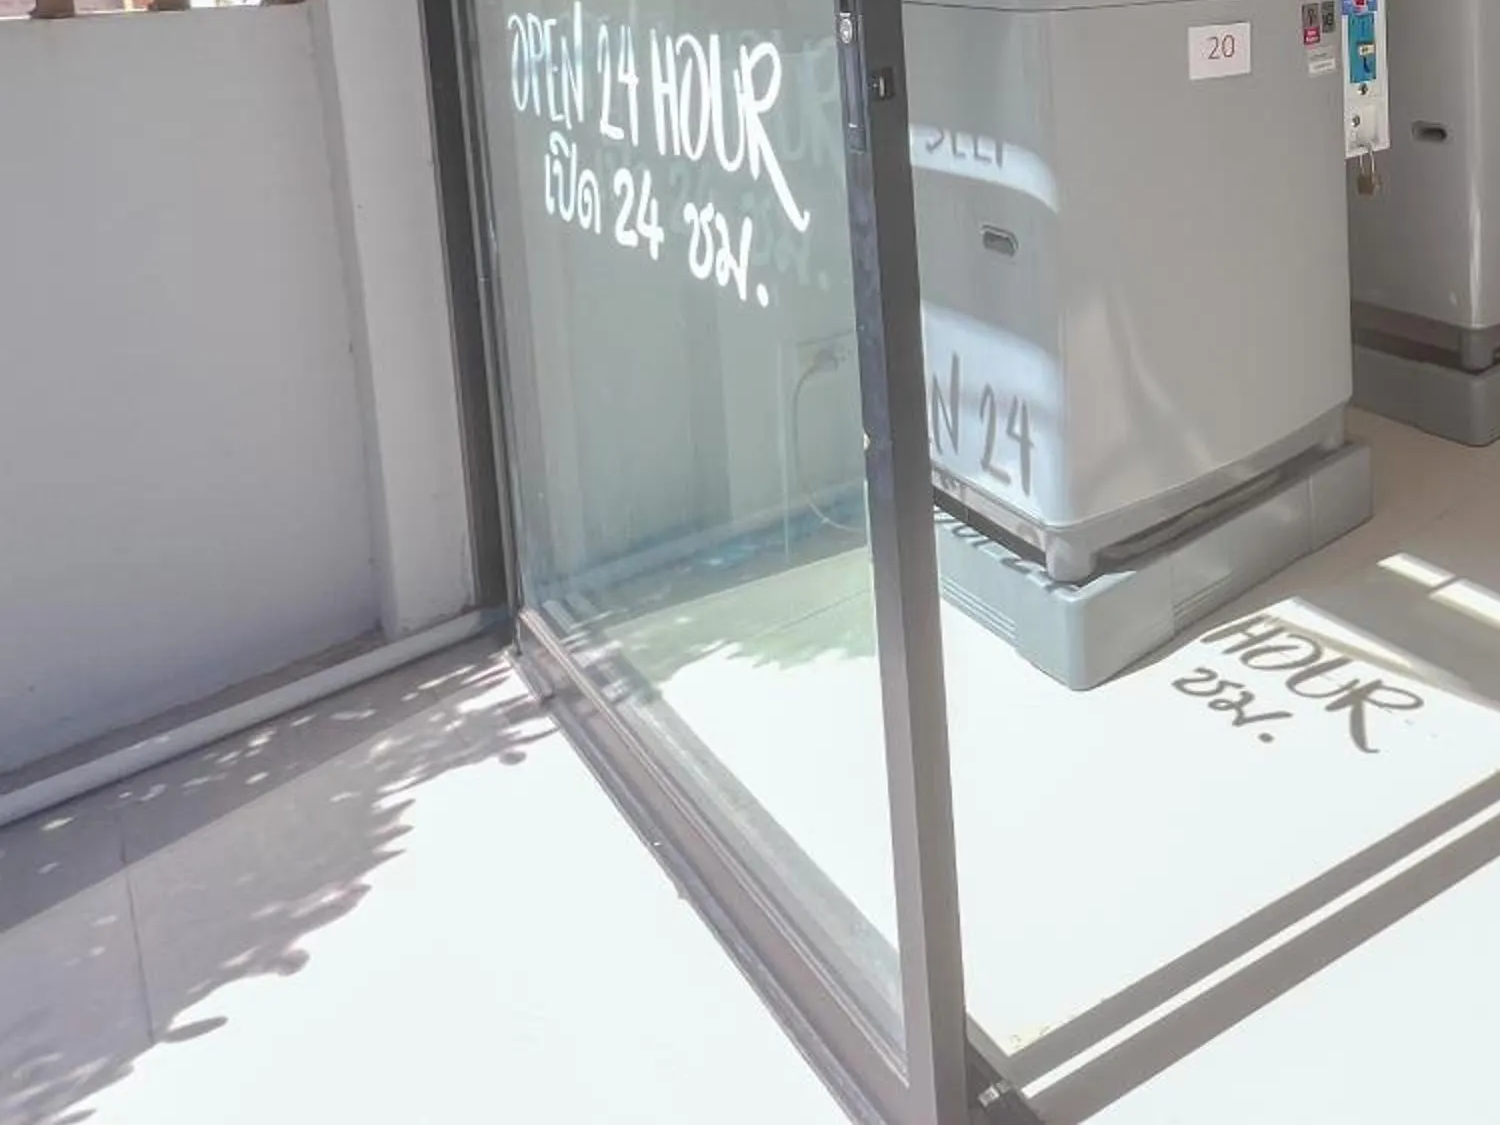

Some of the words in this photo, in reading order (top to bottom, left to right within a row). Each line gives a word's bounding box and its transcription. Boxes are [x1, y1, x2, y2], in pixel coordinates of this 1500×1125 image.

[1205, 33, 1235, 60] 20
[508, 0, 584, 130] OPEN
[597, 23, 639, 147] 24
[650, 27, 810, 232] HOUR
[613, 167, 665, 261] 24
[1200, 612, 1424, 754] HOUR
